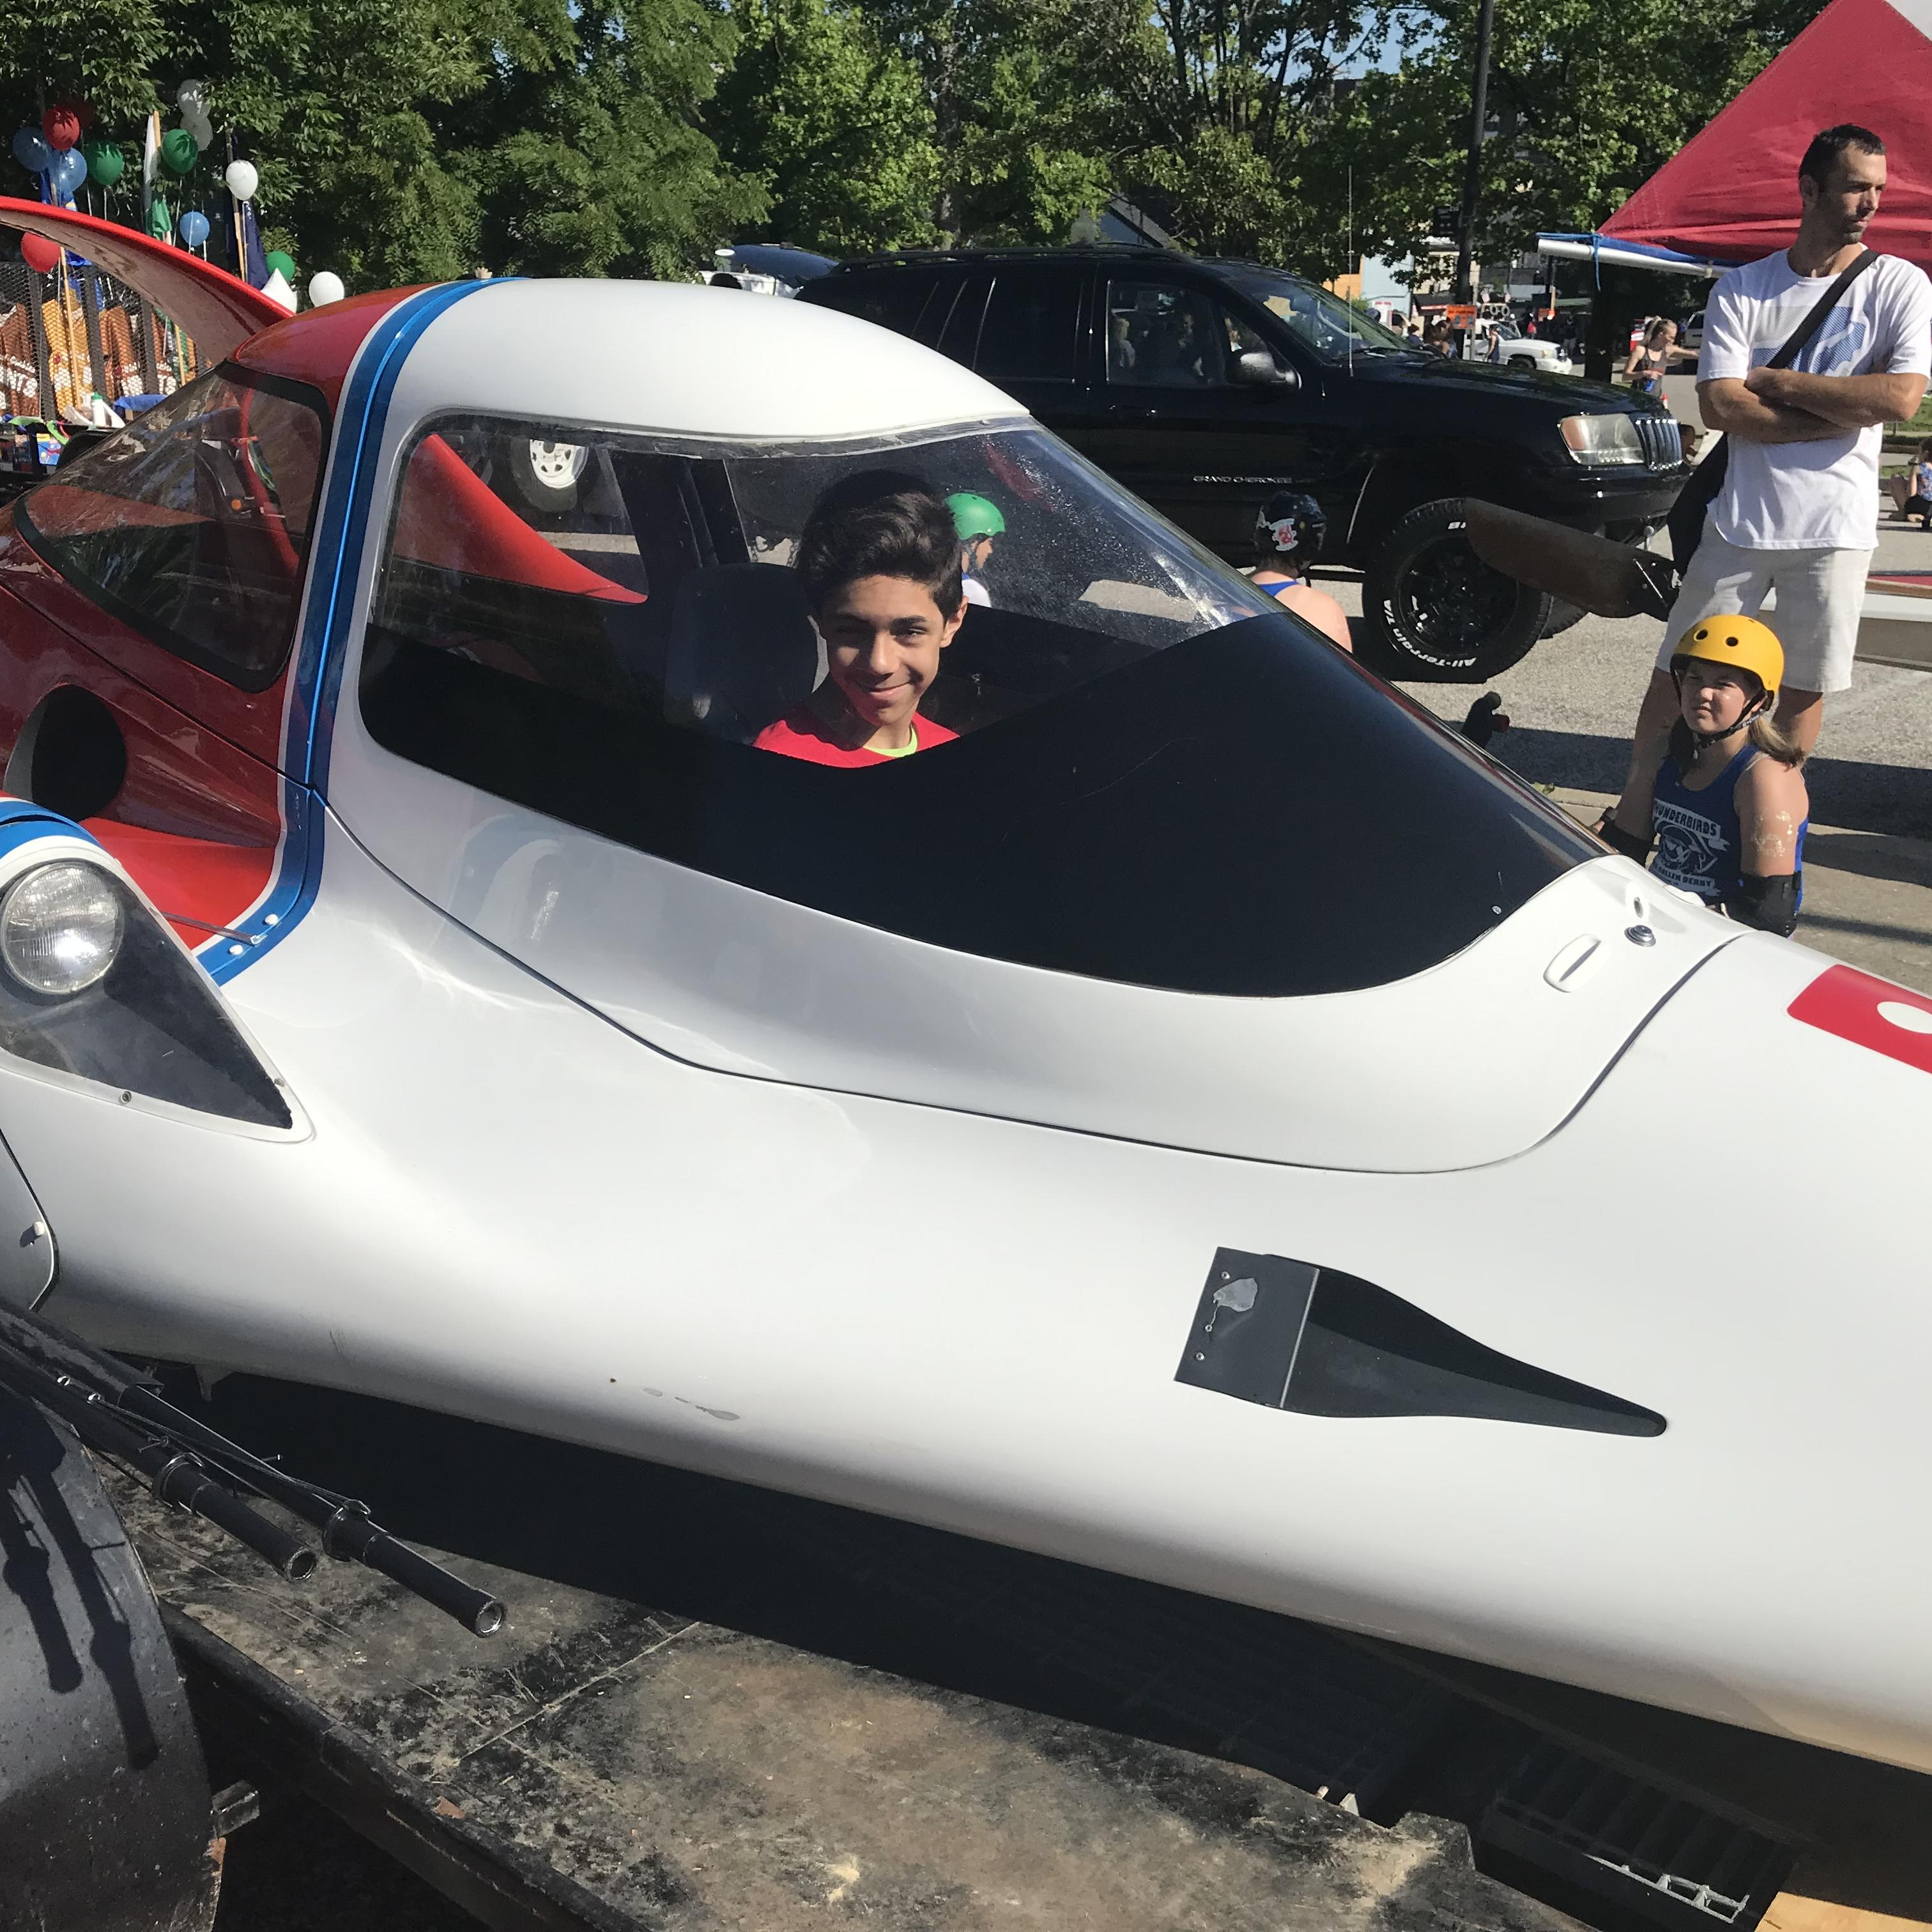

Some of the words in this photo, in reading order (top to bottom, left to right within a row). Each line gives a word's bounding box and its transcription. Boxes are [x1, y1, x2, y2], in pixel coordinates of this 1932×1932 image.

[1233, 476, 1292, 484] CHEROKEE
[1383, 599, 1396, 625] T/A
[1392, 627, 1477, 668] All-Terrain
[1654, 800, 1717, 836] HUNDERBIRDS
[1682, 875, 1712, 887] DERBY
